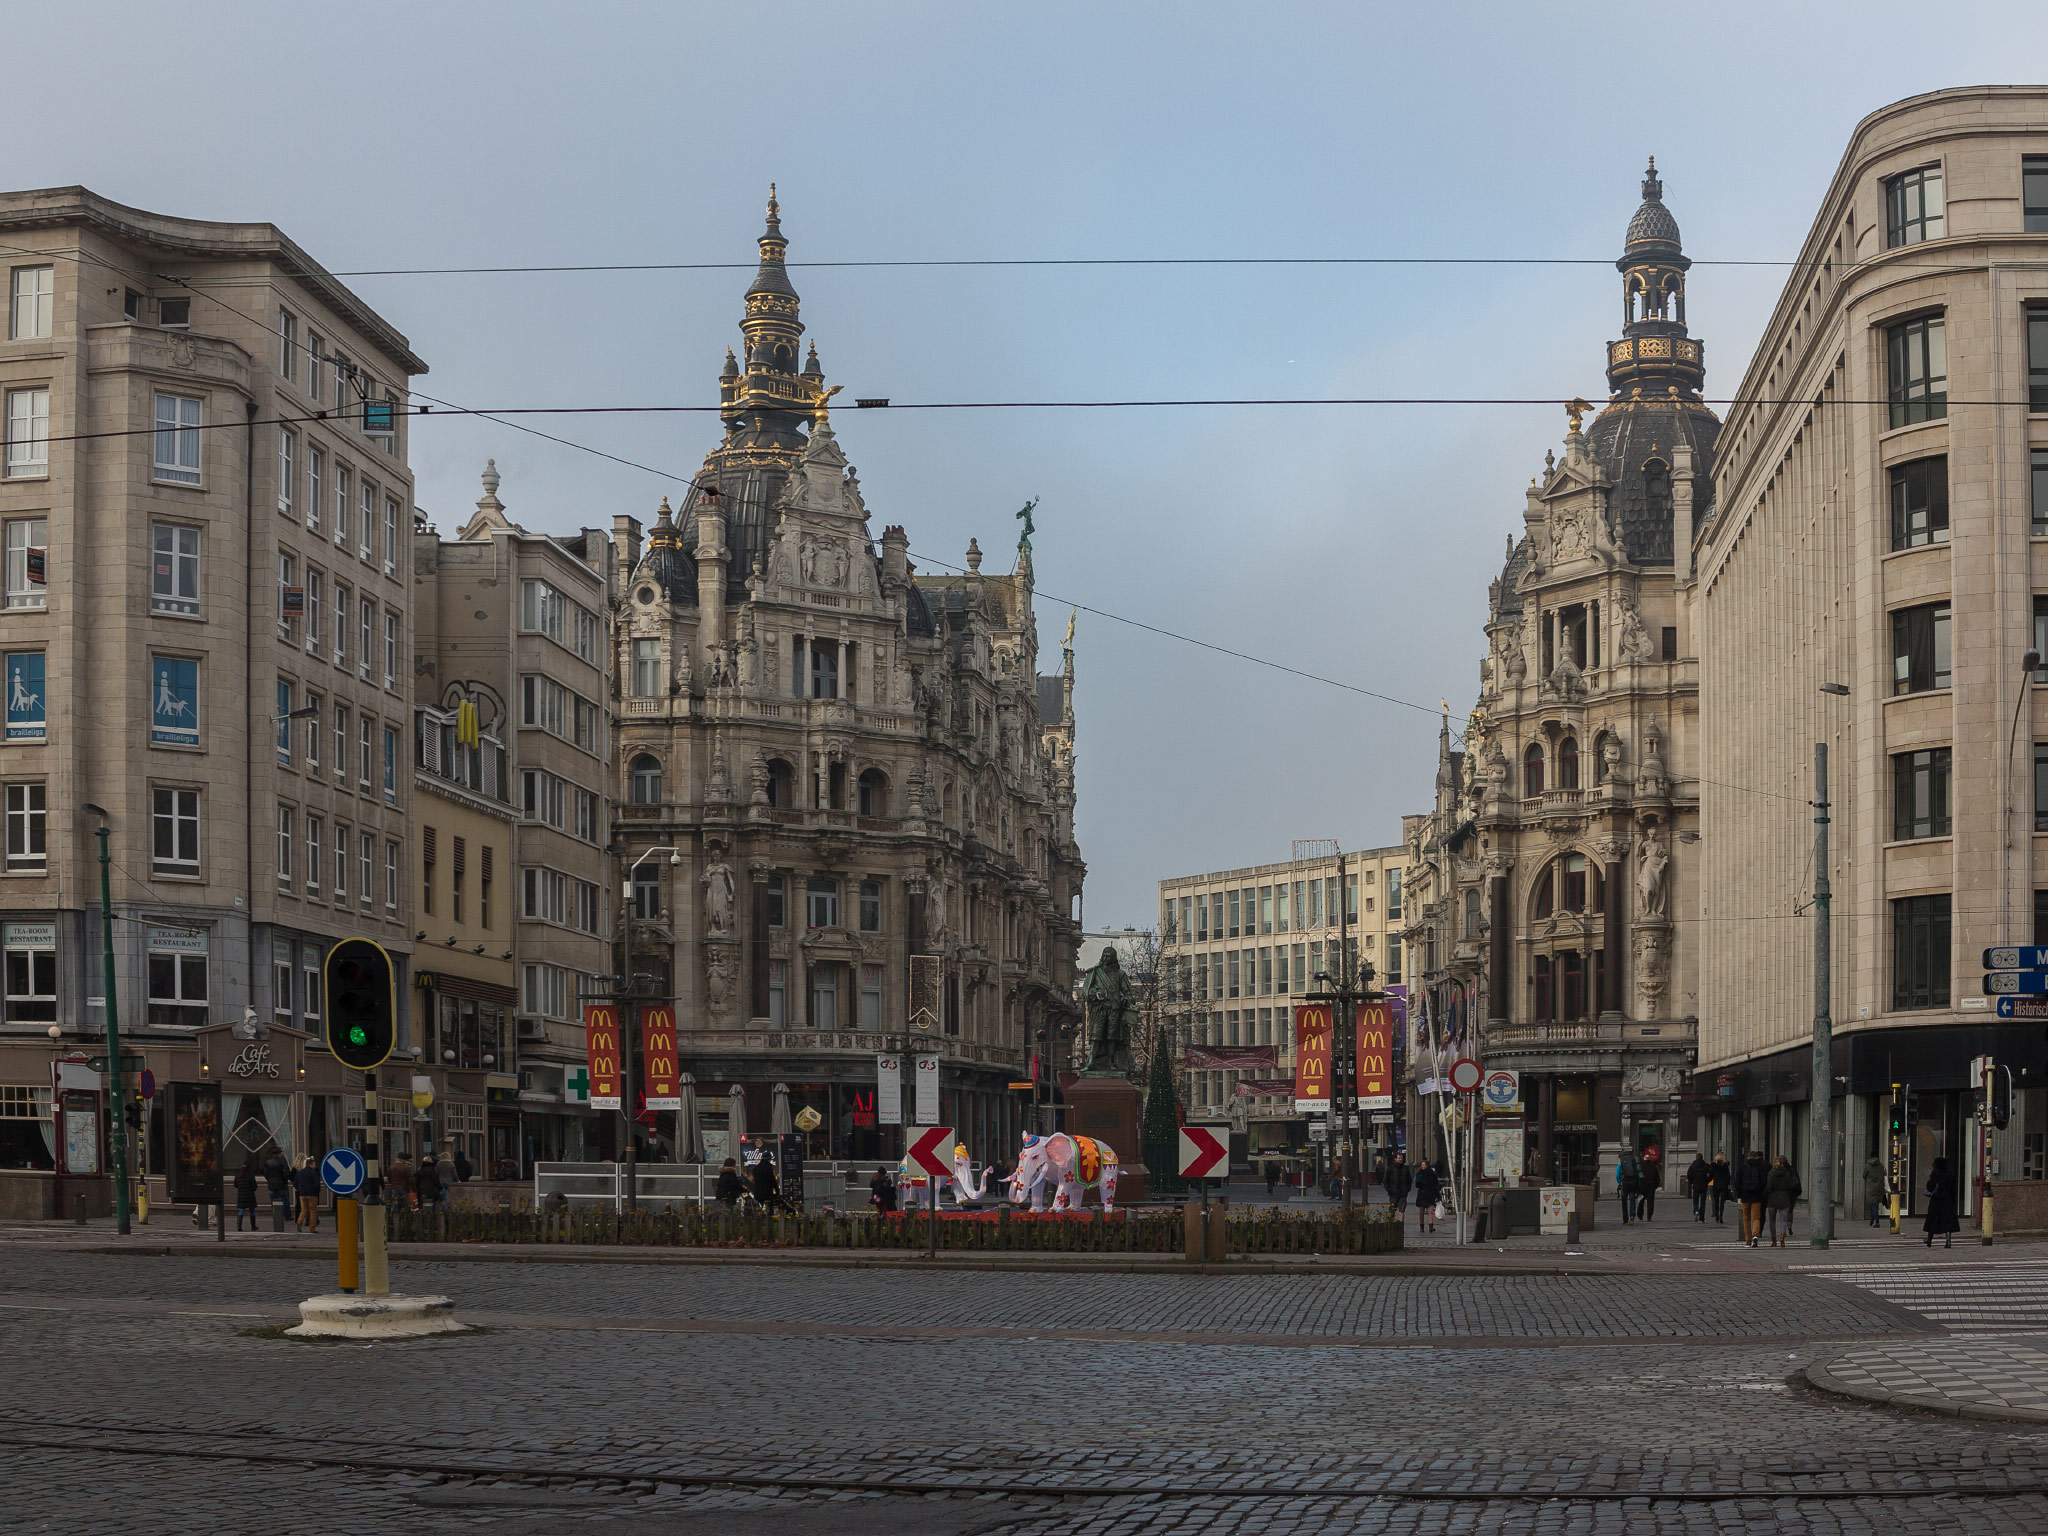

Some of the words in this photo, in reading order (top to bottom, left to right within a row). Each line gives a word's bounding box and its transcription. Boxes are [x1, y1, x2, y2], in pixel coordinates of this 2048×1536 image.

[10, 729, 44, 737] brailleliga
[156, 732, 194, 743] brailleliga
[157, 931, 198, 939] TEA-ROOM
[153, 939, 201, 947] RESTAURANT
[242, 1043, 271, 1064] Cafe
[228, 1054, 251, 1073] des
[240, 1060, 280, 1078] Arts
[851, 1091, 872, 1111] AJ
